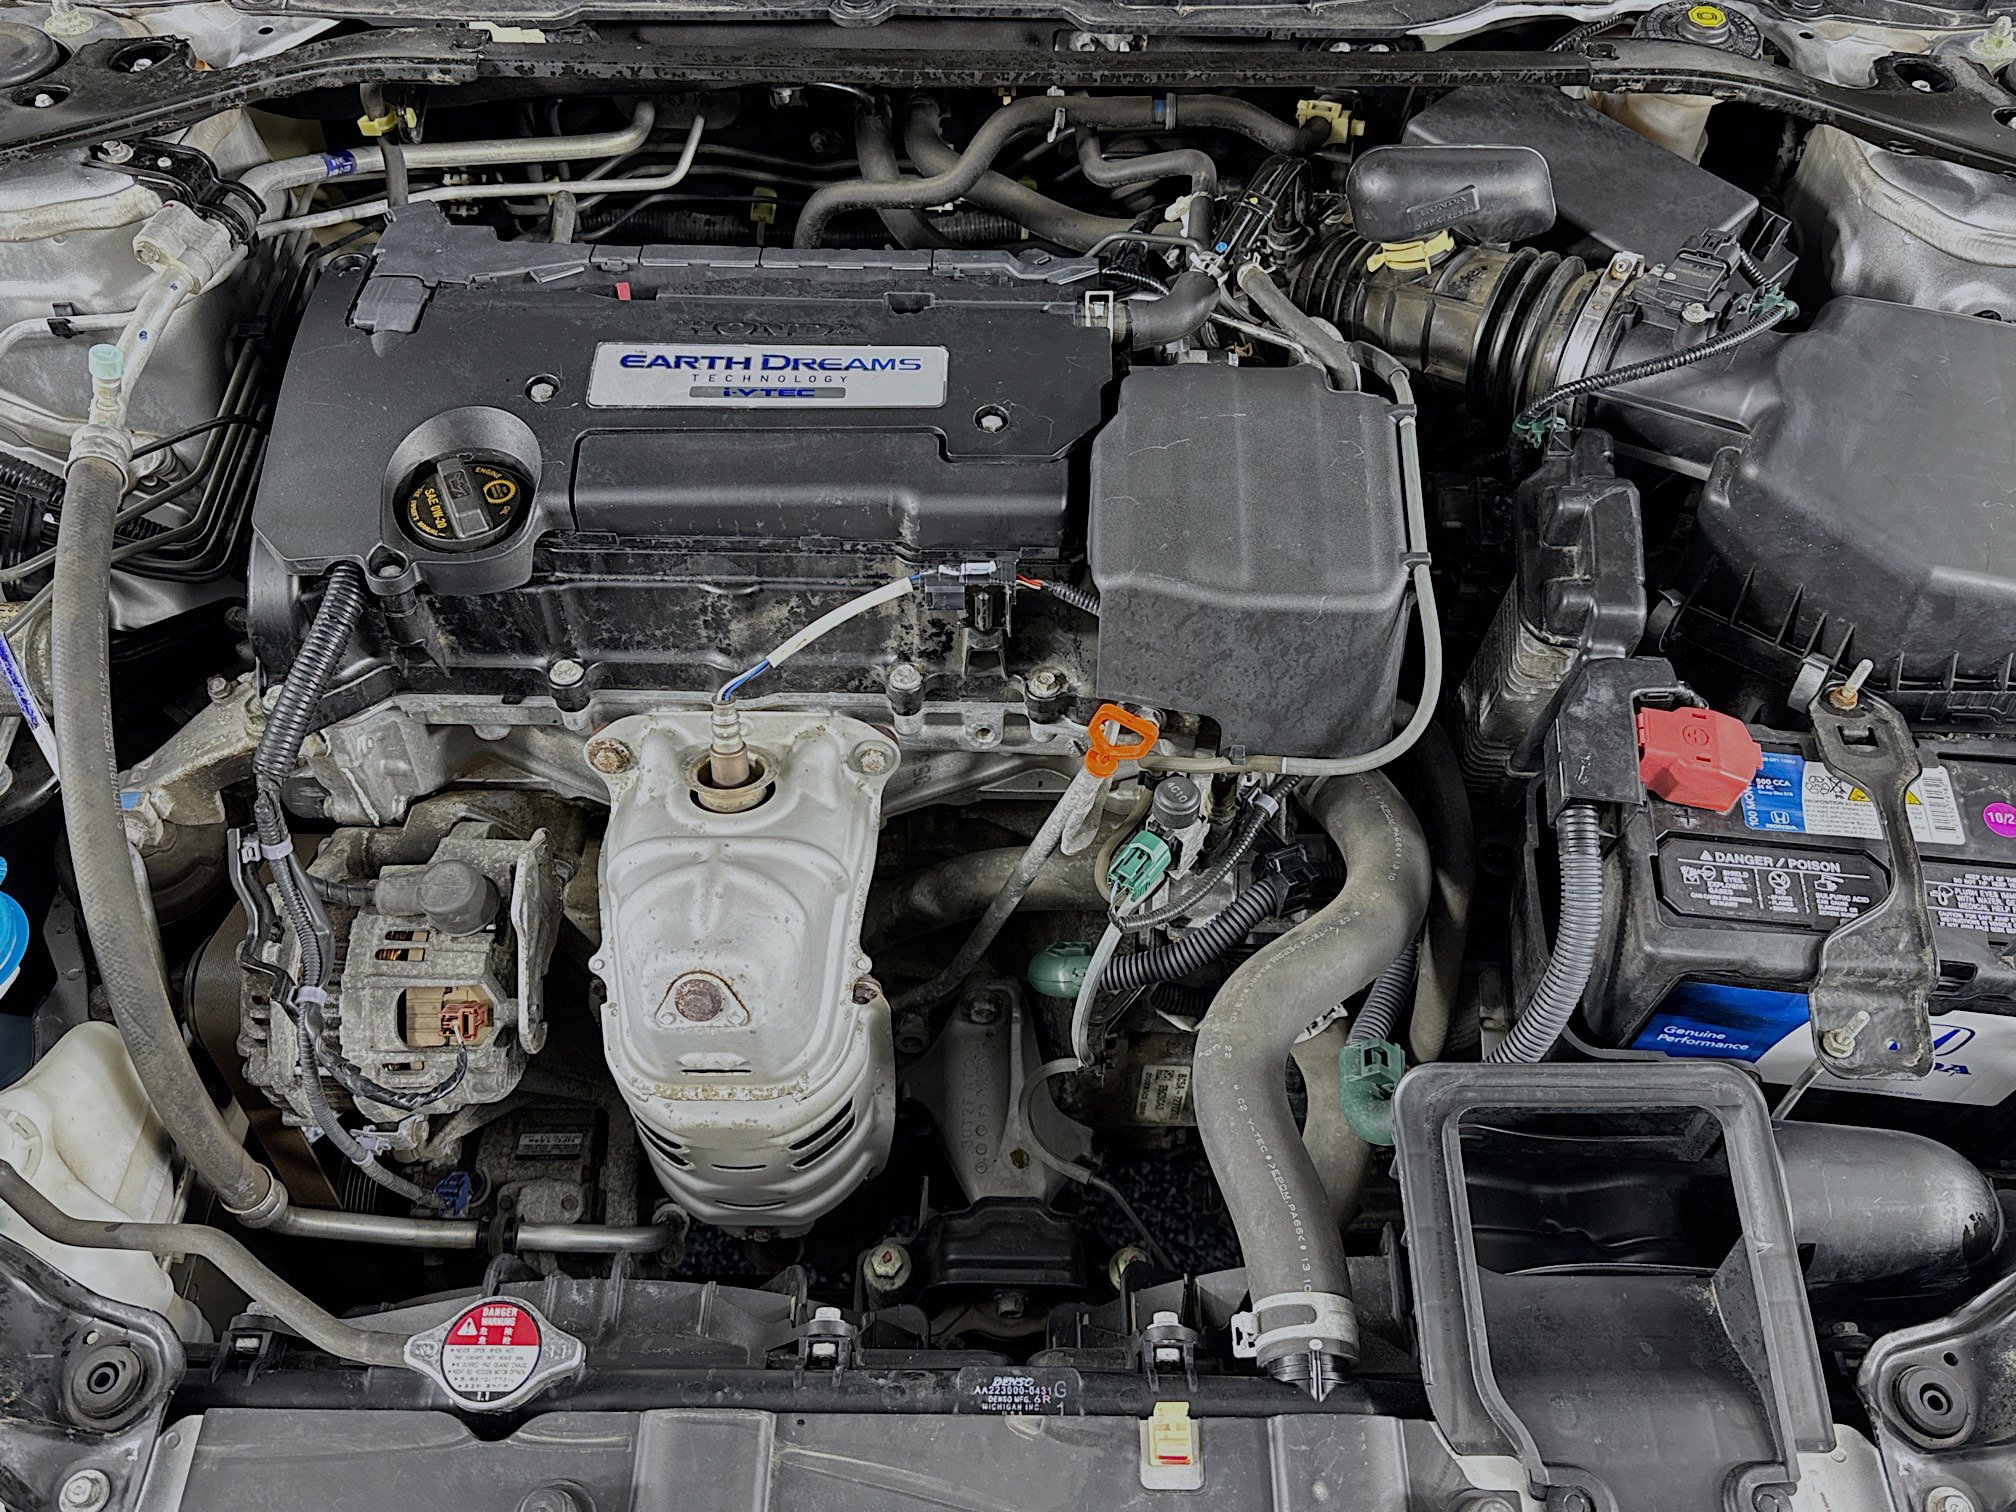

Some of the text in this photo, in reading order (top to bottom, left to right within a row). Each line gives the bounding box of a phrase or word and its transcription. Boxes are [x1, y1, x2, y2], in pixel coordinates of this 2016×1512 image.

[674, 320, 869, 338] HONDA
[619, 353, 923, 372] EARTH DREAMS
[691, 373, 849, 384] TECHNOLOGY
[722, 387, 816, 398] i-VTEC
[475, 466, 502, 479] ENGINE
[424, 488, 439, 506] SAE
[500, 505, 511, 517] OIL
[1773, 779, 1791, 787] CCA
[1747, 811, 1759, 826] 100
[1987, 811, 2016, 825] 10/2
[1714, 851, 1774, 867] DANGER
[1788, 858, 1841, 873] POISON
[1815, 892, 1851, 902] SULFURIC
[1954, 888, 1978, 896] FLUSH
[1979, 890, 1999, 898] EYES
[1958, 902, 1990, 912] MEDICAL
[1663, 1026, 1726, 1039] Genuine
[1657, 1034, 1750, 1050] Performance
[1247, 1118, 1268, 1154] Y-TEC
[482, 1307, 518, 1317] DANGER
[992, 1376, 1034, 1387] DENSO
[1054, 1380, 1067, 1398] G
[987, 1395, 1012, 1403] DENSO
[981, 1403, 1022, 1411] MICHIGAN
